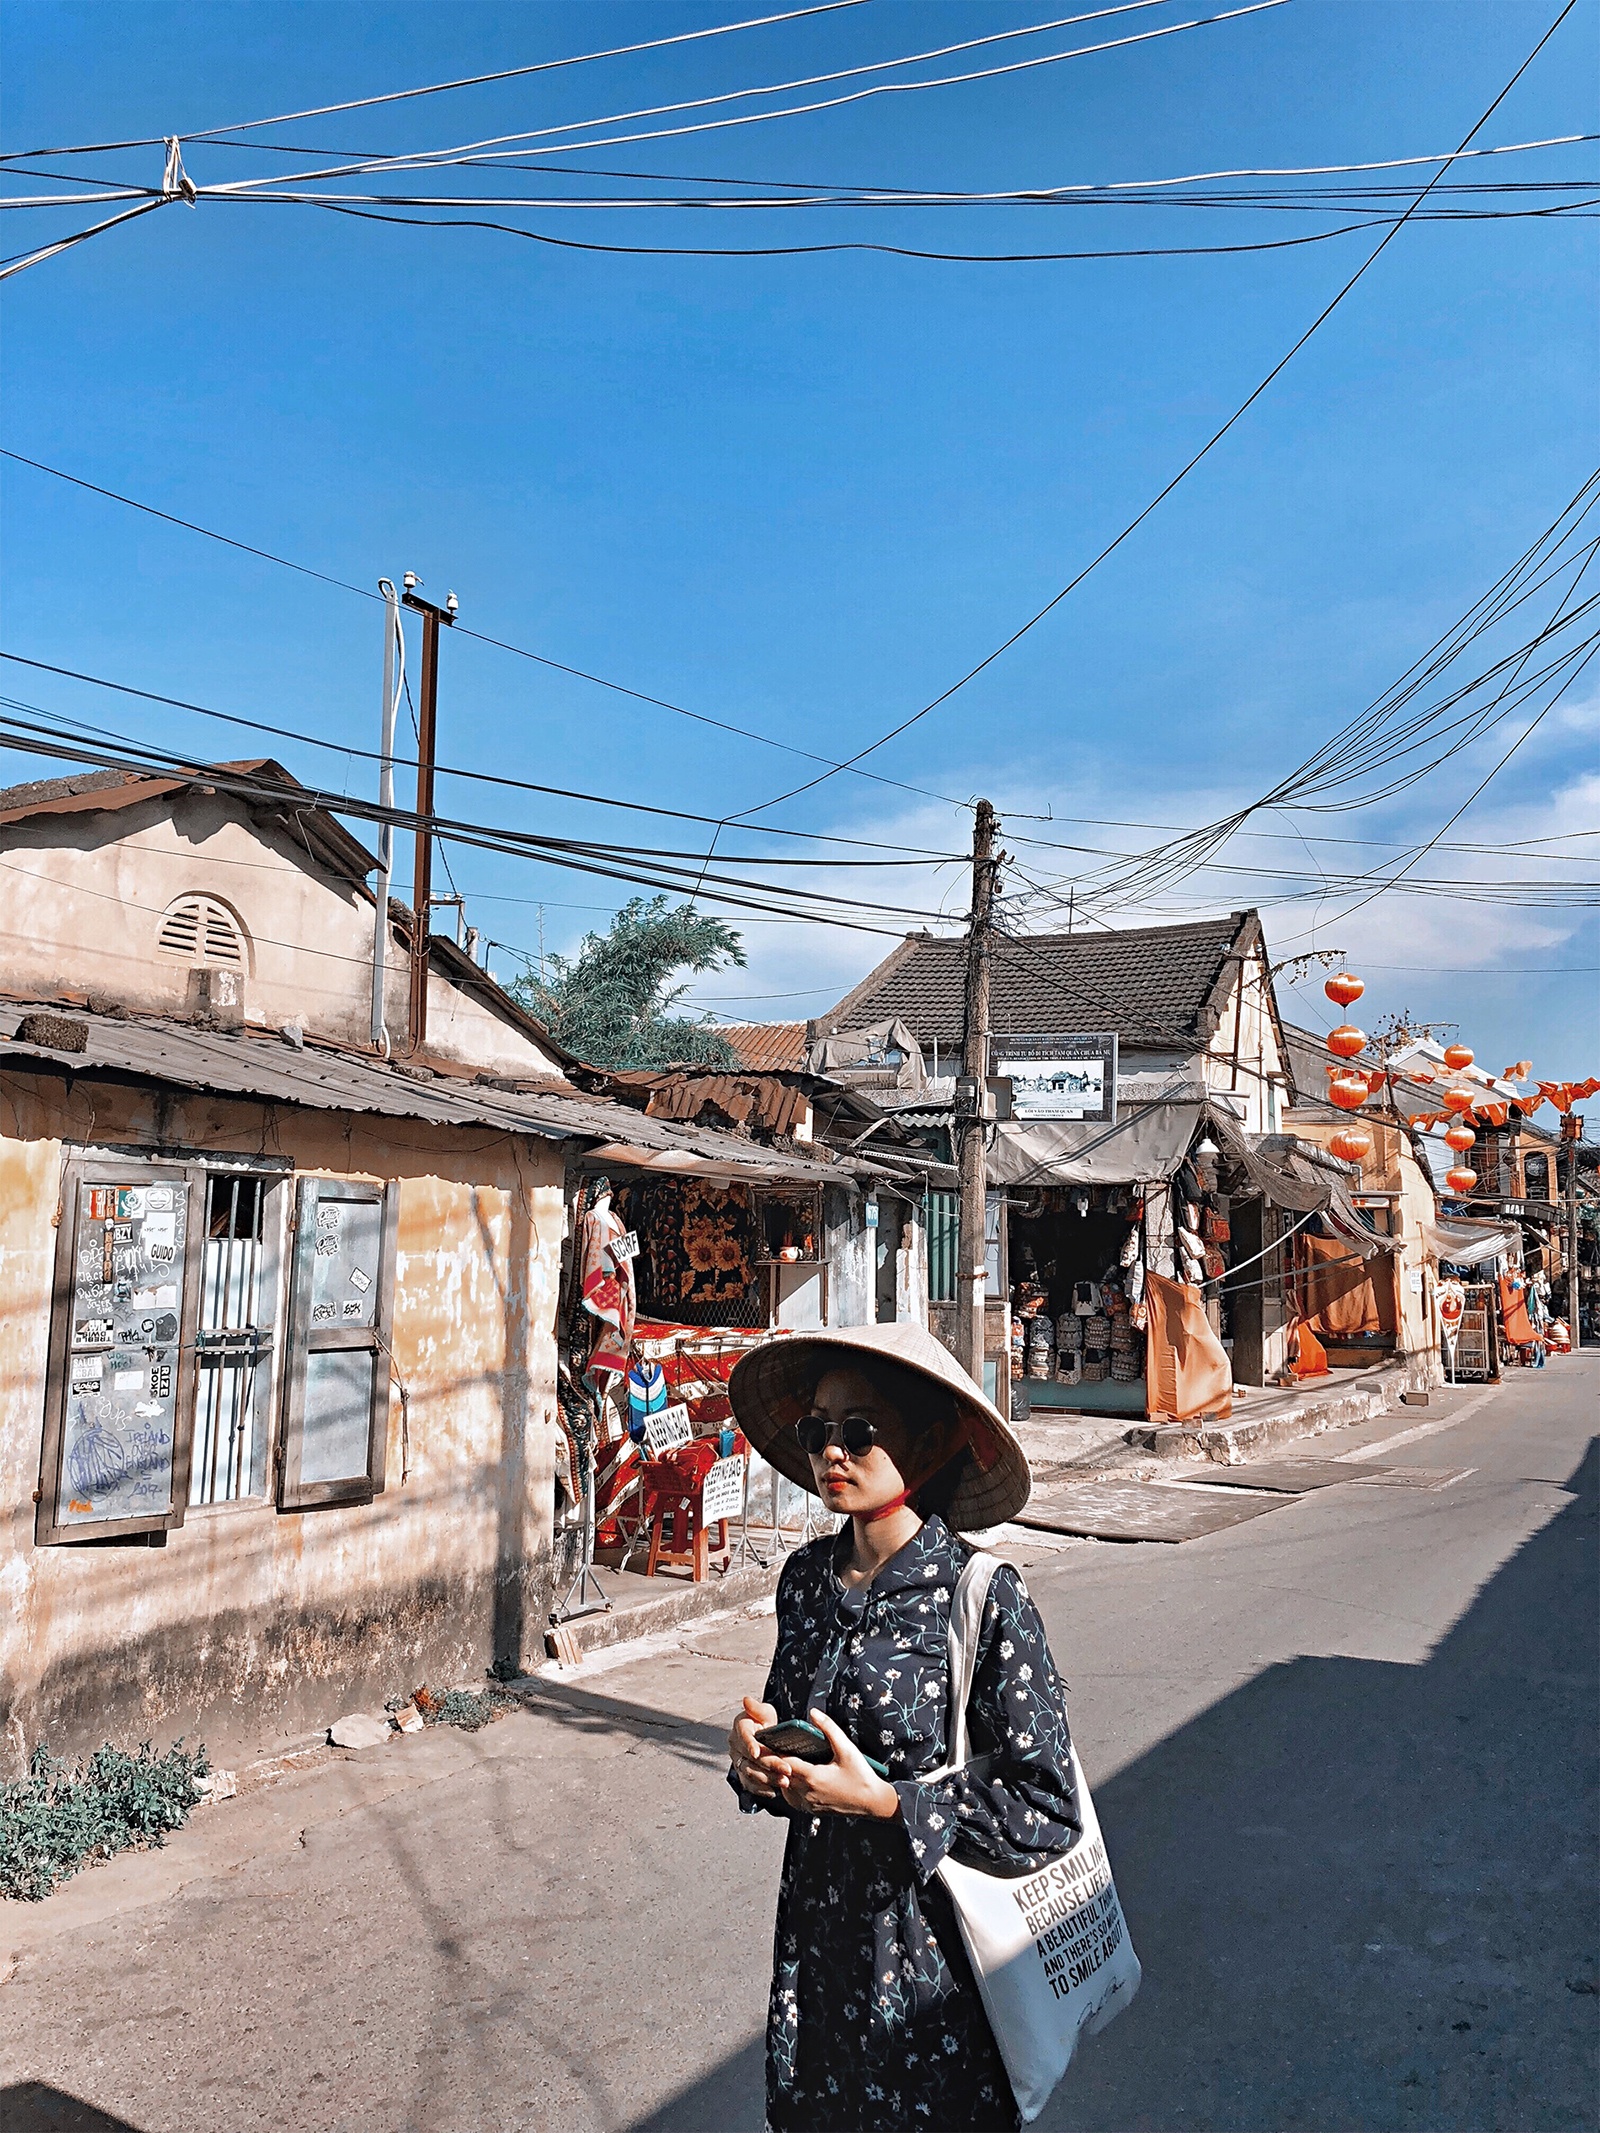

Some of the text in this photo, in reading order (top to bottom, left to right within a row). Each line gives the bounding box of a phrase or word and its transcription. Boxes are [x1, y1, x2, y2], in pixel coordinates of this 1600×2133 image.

[150, 1243, 174, 1261] GUIDO
[160, 1366, 170, 1397] RIZE
[1012, 1874, 1050, 1914] KEEP
[1025, 1886, 1086, 1936] BECAUSE
[1083, 1868, 1105, 1901] LIFE
[1036, 1938, 1046, 1959] A
[1043, 1902, 1100, 1954] BEAUTIFUL
[1043, 1953, 1066, 1978] AND
[1063, 1930, 1099, 1964] THERE'S
[1098, 1920, 1107, 1938] SO
[1048, 1918, 1124, 2000] TO SMILE ABOUT
